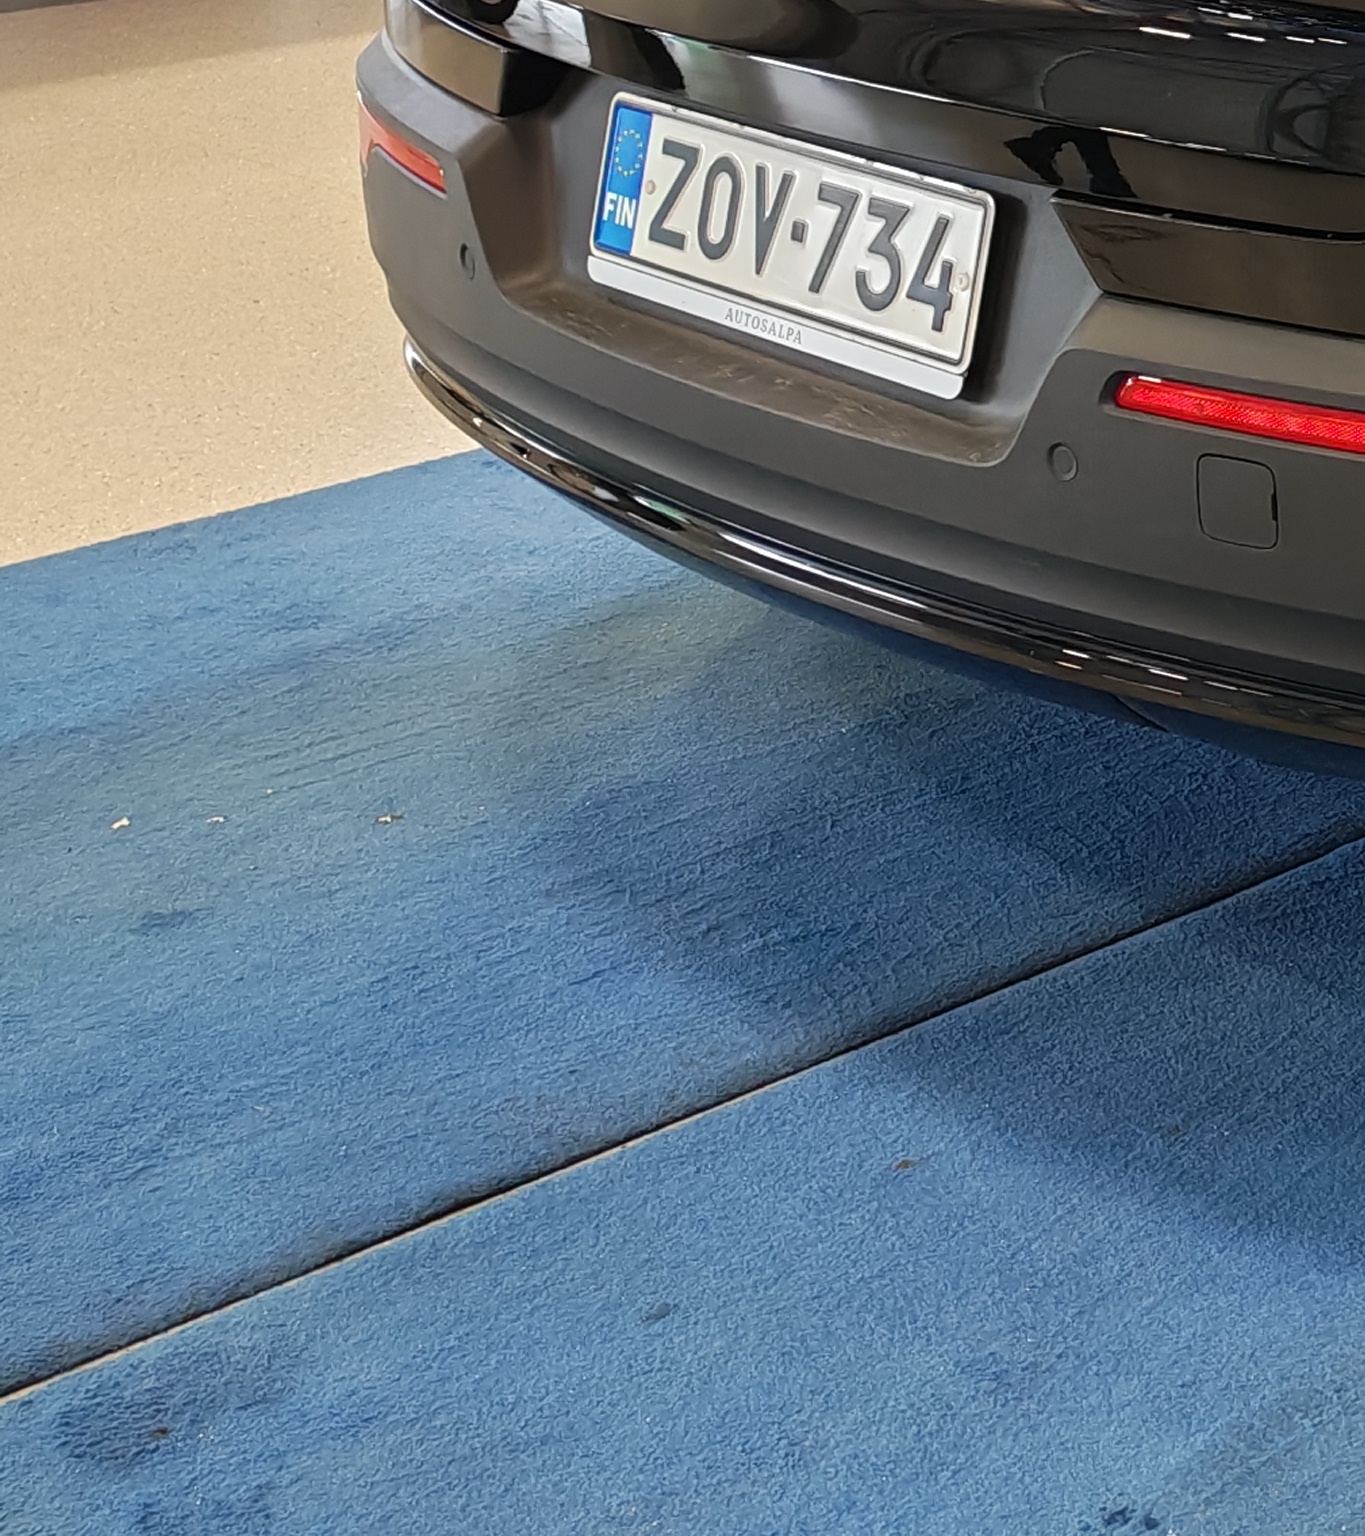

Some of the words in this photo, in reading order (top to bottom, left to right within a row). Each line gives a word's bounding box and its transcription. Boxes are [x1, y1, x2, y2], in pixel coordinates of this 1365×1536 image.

[602, 192, 637, 230] FIN
[647, 137, 956, 333] ZOV-734
[722, 306, 804, 346] AUTOSALPA
